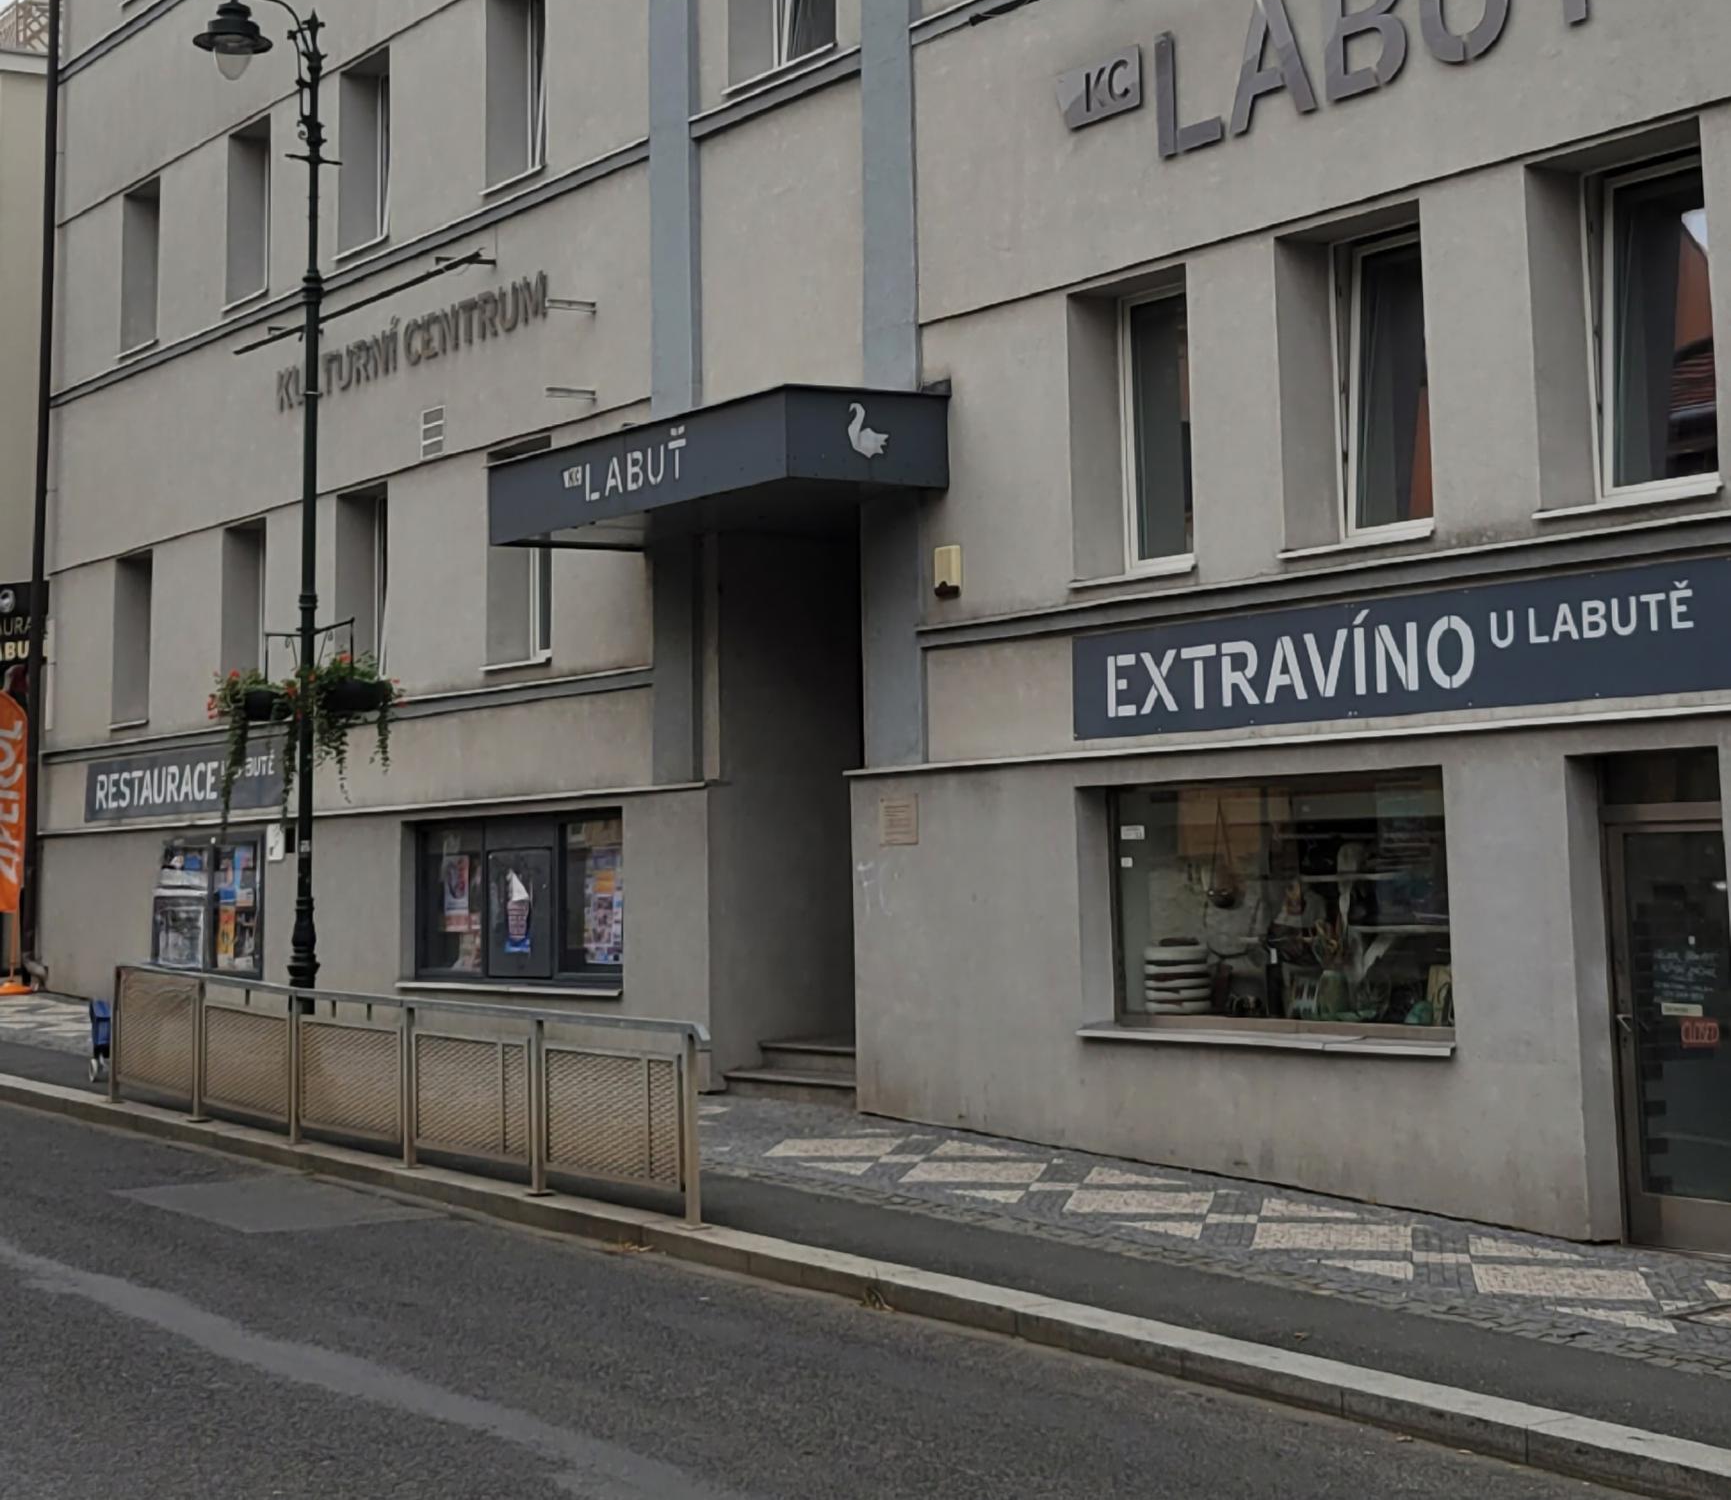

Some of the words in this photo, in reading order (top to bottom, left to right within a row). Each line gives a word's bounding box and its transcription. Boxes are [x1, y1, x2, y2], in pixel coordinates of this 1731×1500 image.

[1084, 58, 1131, 113] KC
[275, 314, 399, 413] KUTURNÍ
[403, 270, 548, 367] CENTRUM
[585, 425, 687, 502] LABUŤ
[1106, 608, 1476, 718] EXTRAVÍNO
[1489, 609, 1515, 650] U
[1527, 580, 1695, 645] LABUTĚ
[95, 761, 219, 810] RESTAURACE
